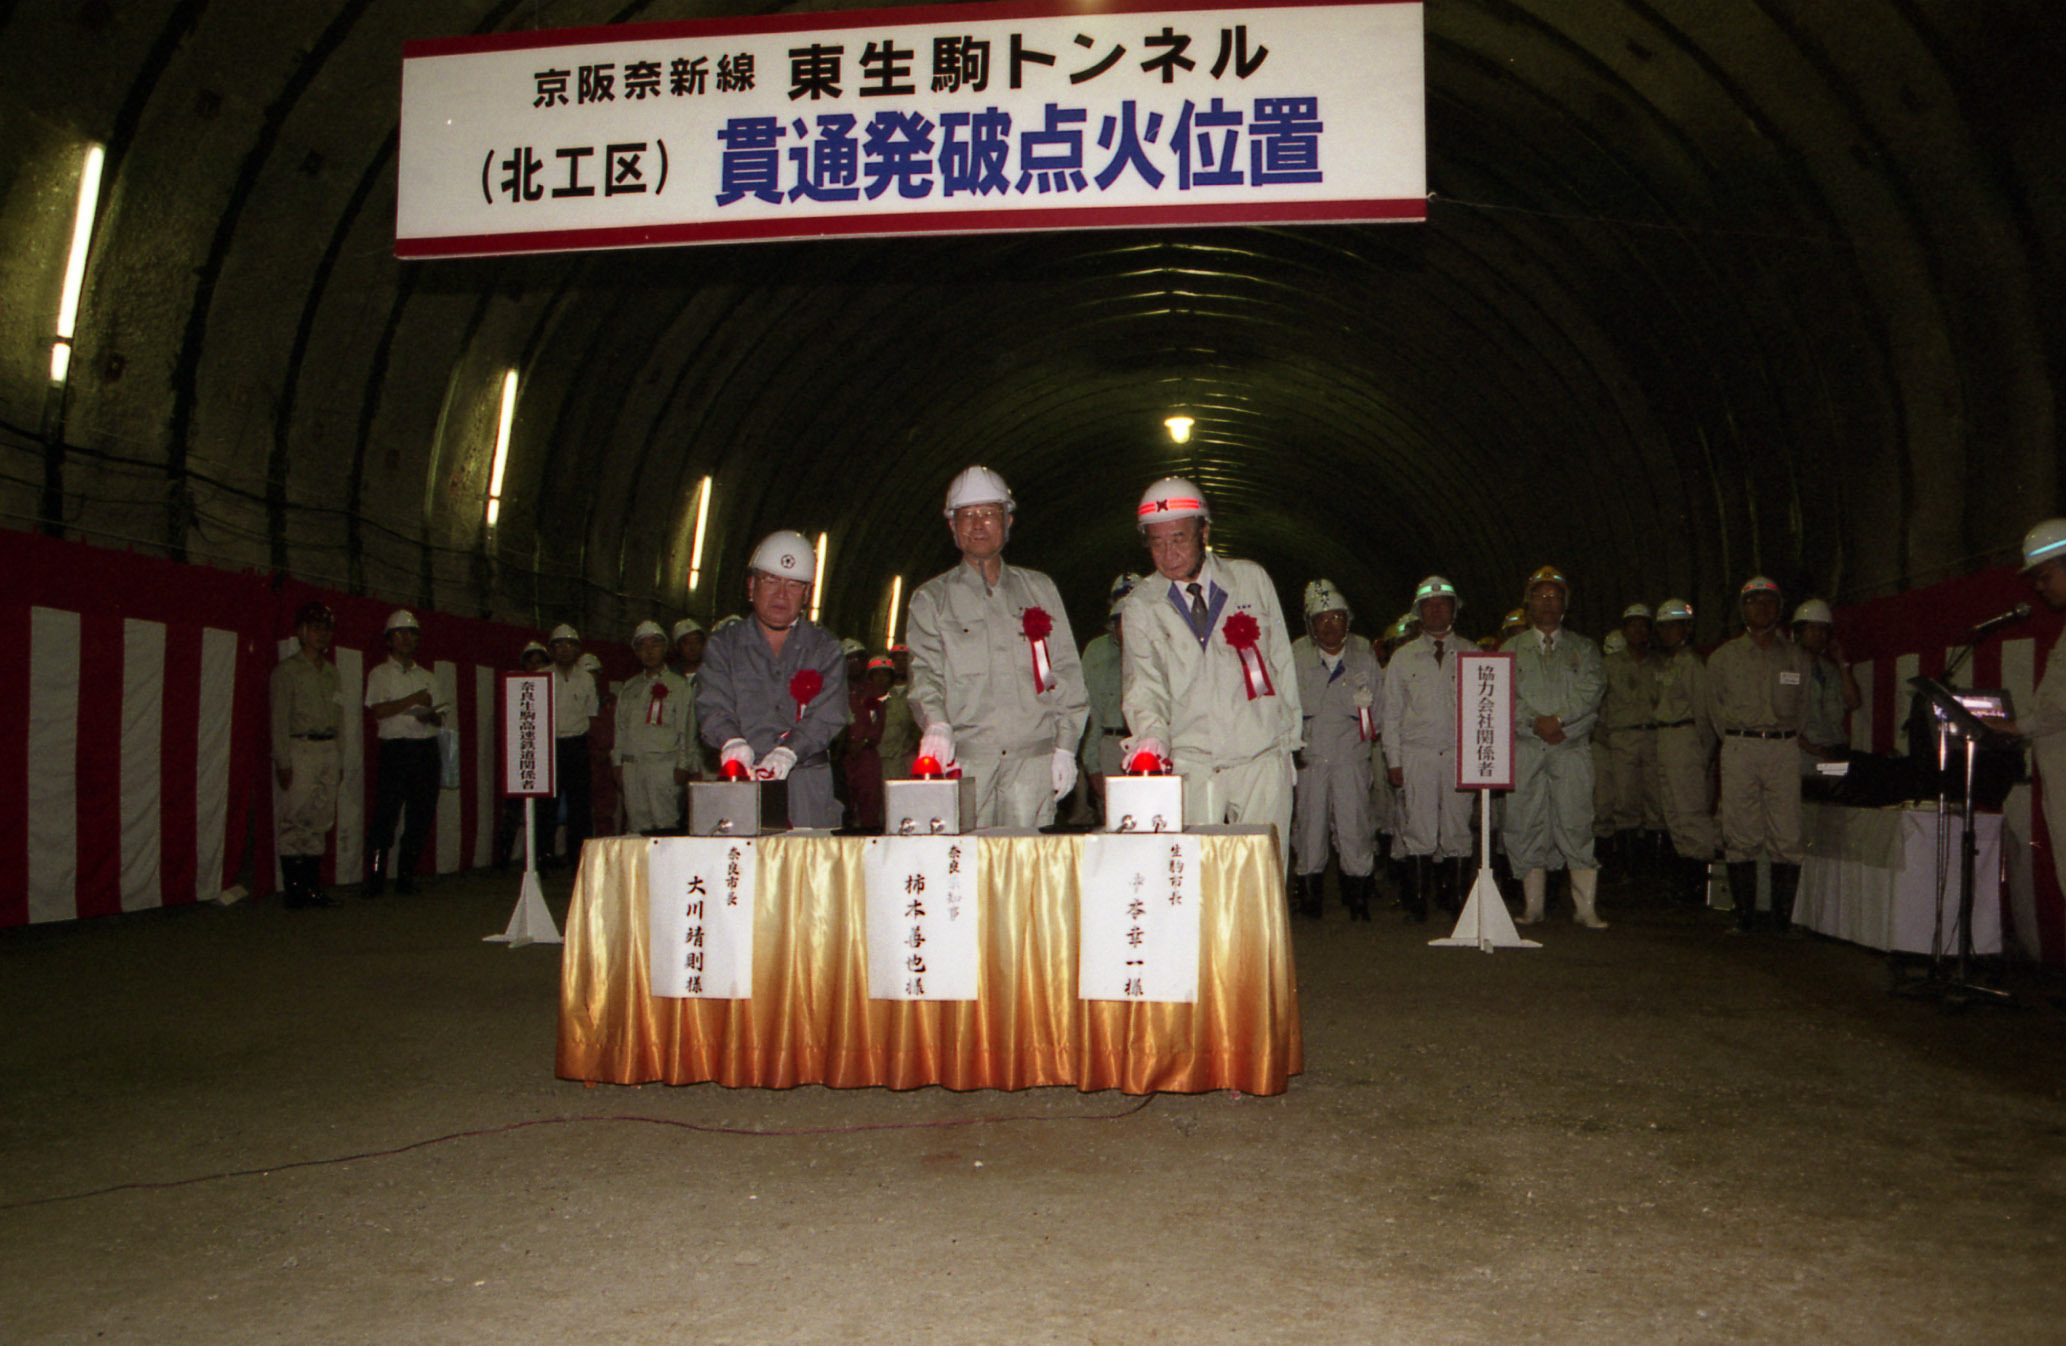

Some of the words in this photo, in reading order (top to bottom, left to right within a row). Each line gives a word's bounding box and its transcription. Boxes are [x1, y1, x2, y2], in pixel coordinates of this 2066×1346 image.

[533, 52, 756, 109] 京阪奈新線
[787, 24, 1269, 101] 東生駒トンネル
[481, 138, 669, 205] (北工区)
[714, 96, 1323, 207] 貫通発破点火位置
[518, 680, 536, 790] 奈良生駒高速鉄道関係者
[1476, 664, 1495, 777] 協力会社関係者
[725, 846, 741, 907] 奈良市長
[947, 845, 963, 922] 奈良知事
[1168, 843, 1185, 906] 生駒市長
[685, 875, 706, 994] 大川靖則様
